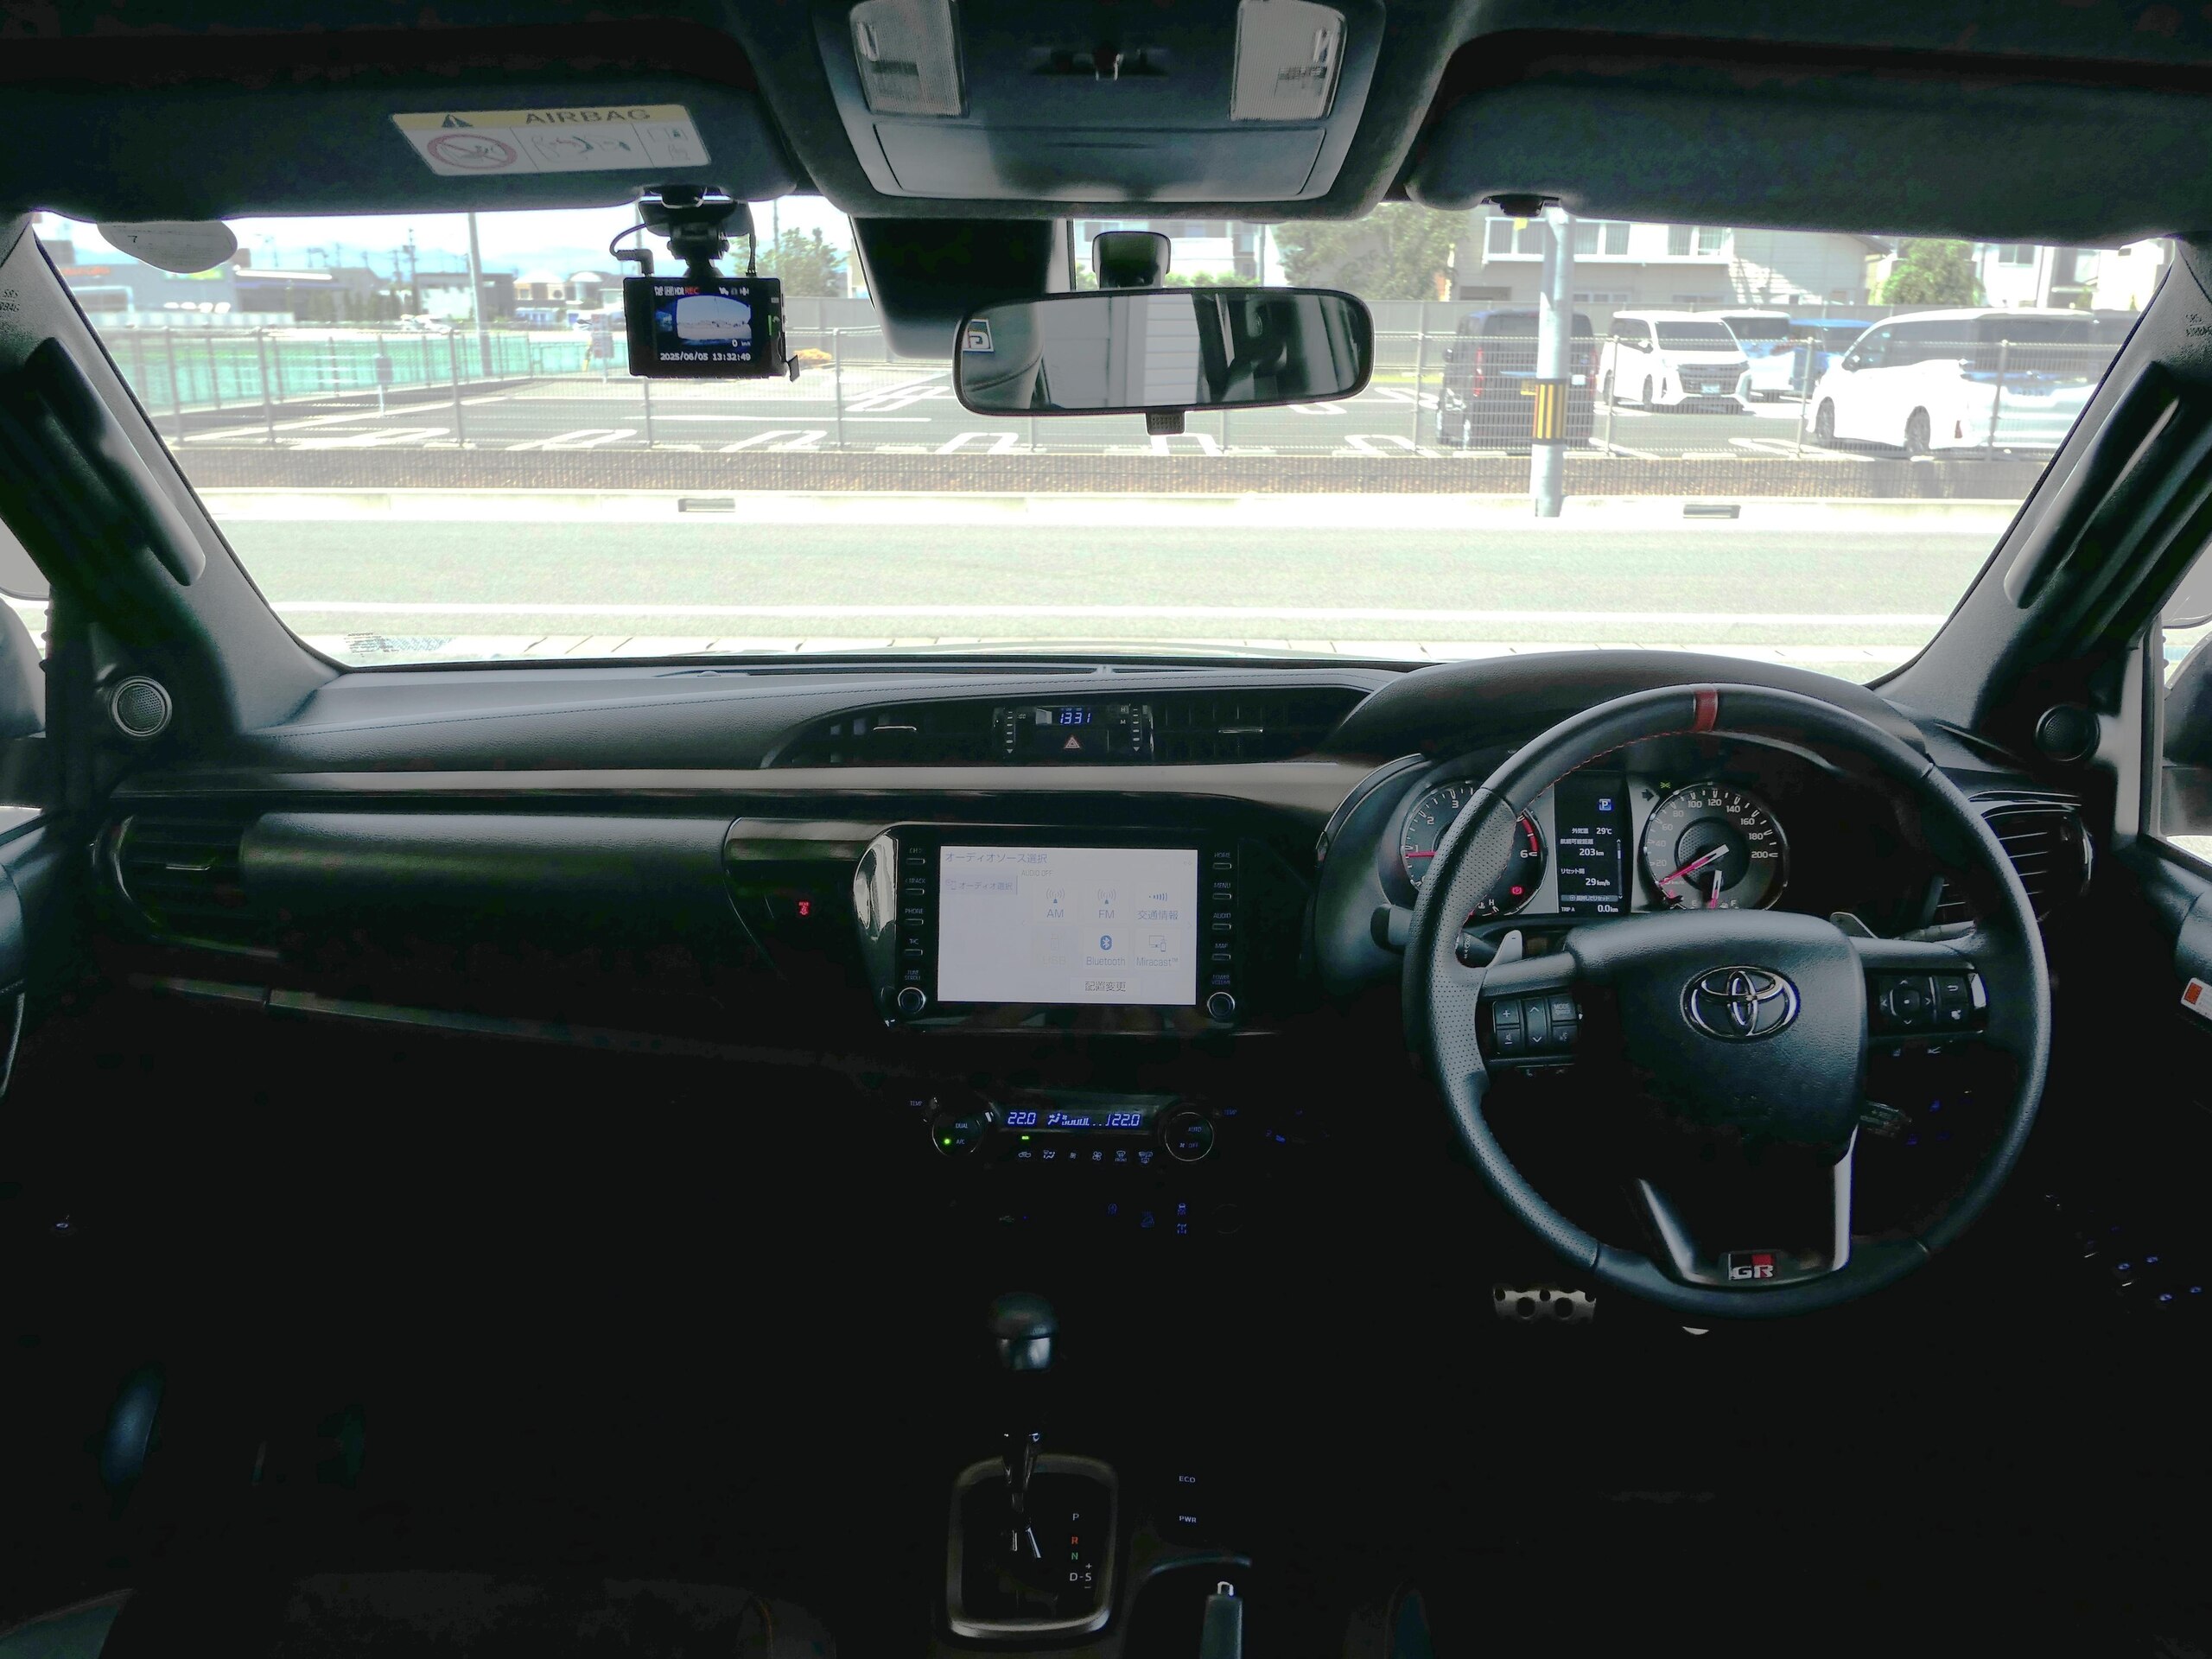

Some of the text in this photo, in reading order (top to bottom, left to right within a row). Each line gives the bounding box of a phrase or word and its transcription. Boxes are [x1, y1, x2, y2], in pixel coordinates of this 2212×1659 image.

[525, 108, 650, 124] AIRBAG
[712, 353, 751, 361] 13:32:49
[945, 853, 1048, 864] オーディオソース選択
[958, 881, 1013, 890] オーディオ選択
[1046, 909, 1064, 918] AM
[1098, 910, 1115, 918] FM
[1137, 910, 1179, 921] 交通情報
[1085, 956, 1126, 966] Bluetooth
[1084, 981, 1127, 992] 配置変更
[1007, 1112, 1037, 1125] 22.0
[1111, 1113, 1141, 1126] 22.0
[1731, 1264, 1774, 1280] GR
[1178, 1475, 1197, 1484] ECO
[1071, 1536, 1079, 1545] R
[1071, 1552, 1079, 1560] N
